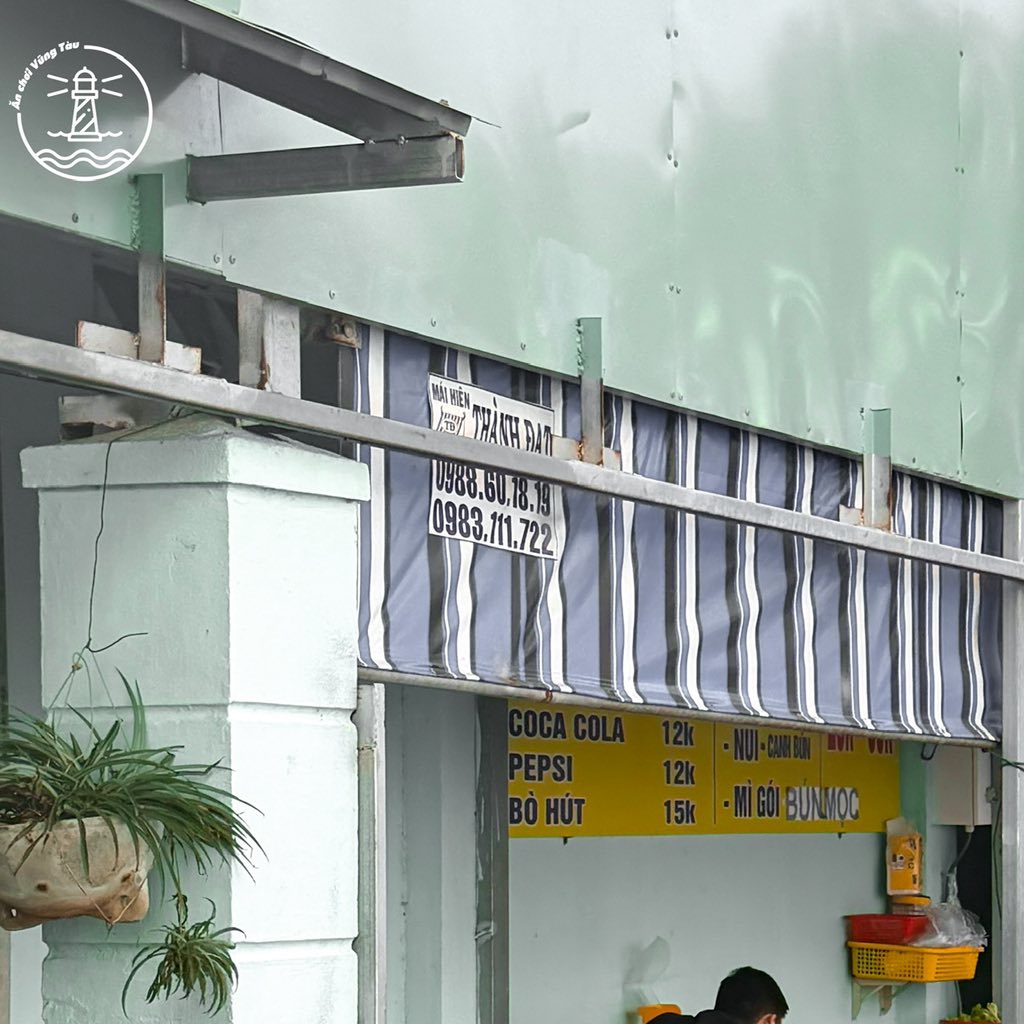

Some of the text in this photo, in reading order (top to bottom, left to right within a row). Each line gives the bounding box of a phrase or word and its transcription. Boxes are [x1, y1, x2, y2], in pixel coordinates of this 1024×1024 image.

[431, 380, 470, 411] MÁI HIÊN
[432, 498, 554, 557] 0983.111.722
[509, 708, 695, 747] COCA COLA 12k
[734, 728, 759, 762] NUI
[767, 734, 792, 759] CANH
[509, 752, 696, 785] PEPSI 12k
[509, 790, 696, 825] BÒ HÚT 15k
[734, 779, 752, 818] MÌ
[757, 779, 780, 818] GÓI
